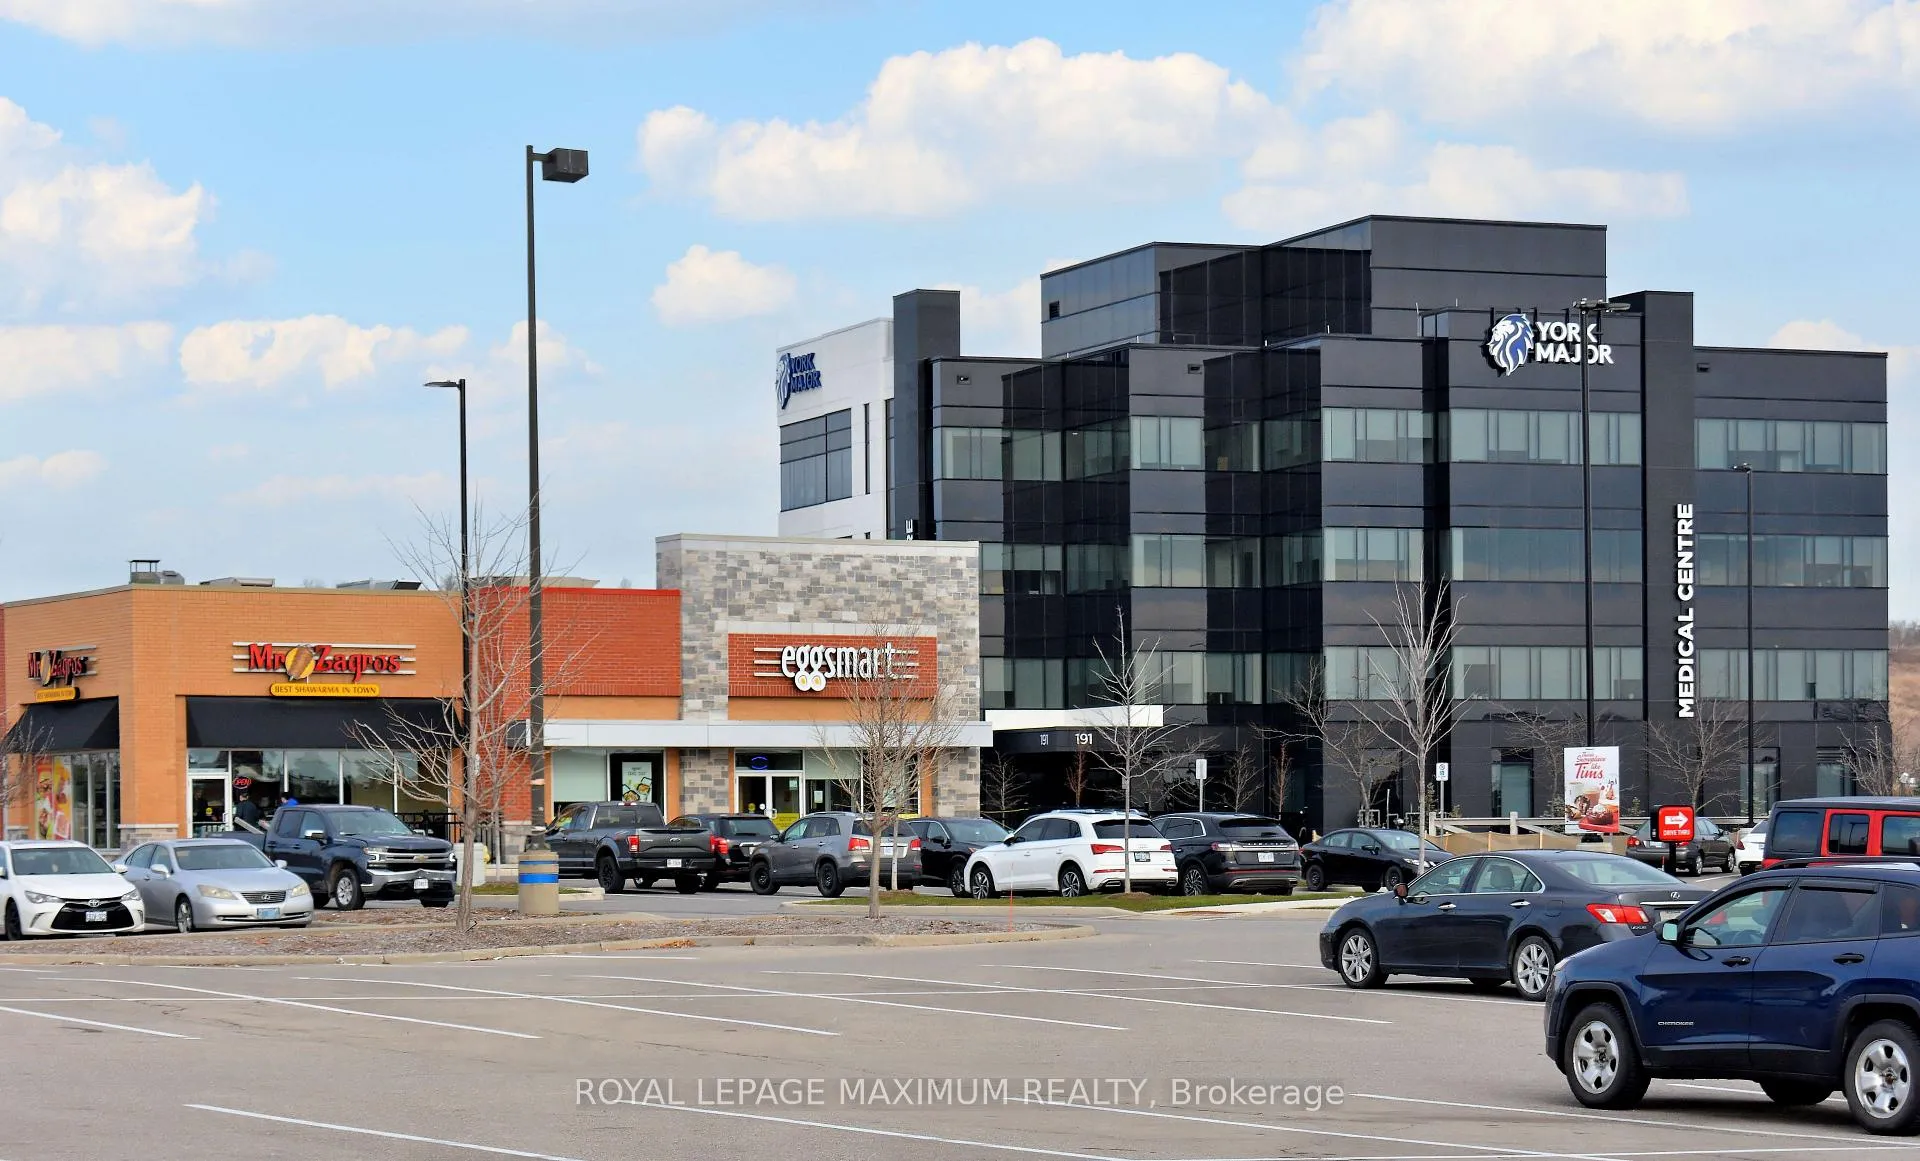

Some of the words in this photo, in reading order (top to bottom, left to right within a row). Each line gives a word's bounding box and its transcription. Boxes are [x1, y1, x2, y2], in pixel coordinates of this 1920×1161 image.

[1535, 321, 1598, 343] YORK
[789, 353, 816, 374] YORK
[1535, 342, 1614, 364] MAJOR
[790, 370, 822, 393] MAJOR
[1677, 503, 1694, 601] CENTRE
[248, 643, 286, 671] Mr
[782, 641, 895, 691] eggsmart
[1678, 607, 1694, 718] MEDICAL
[274, 685, 293, 694] BEST
[294, 685, 339, 695] SHAWARMA
[341, 686, 351, 694] IN
[353, 686, 377, 695] TOWN
[1040, 734, 1049, 746] 191
[1075, 733, 1093, 745] 191
[1575, 762, 1604, 779] Tims
